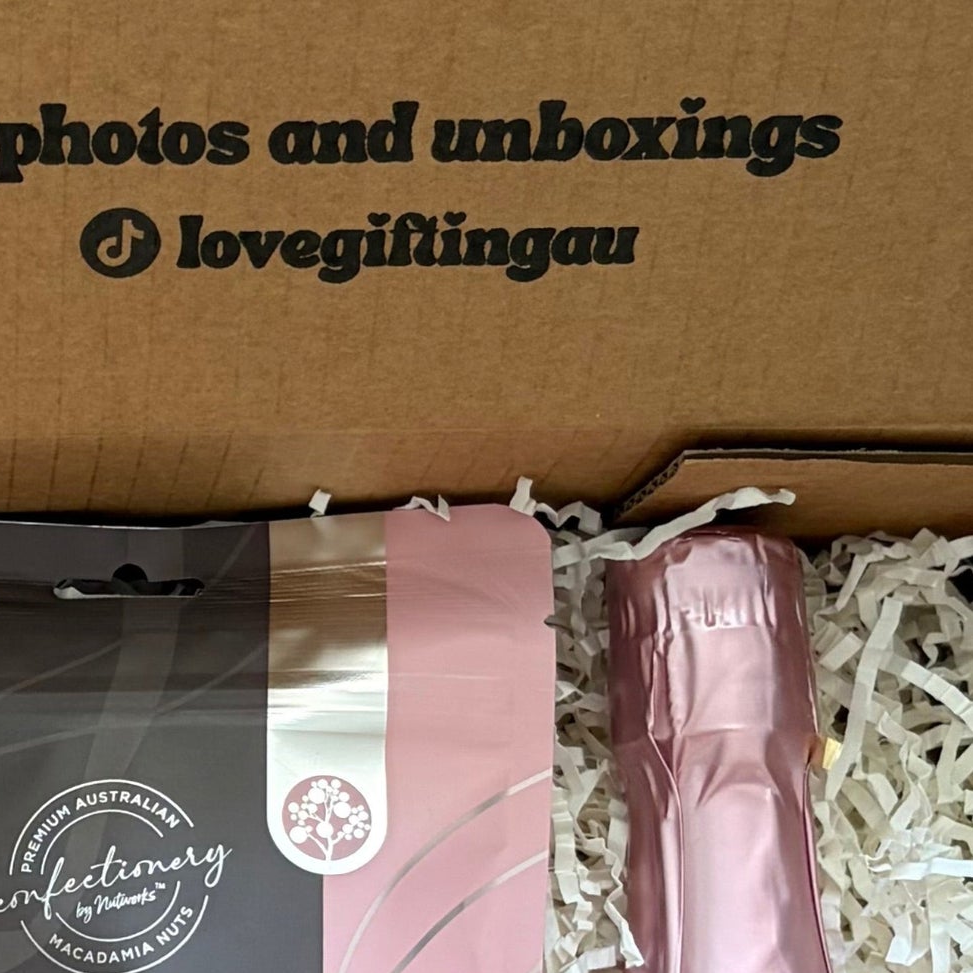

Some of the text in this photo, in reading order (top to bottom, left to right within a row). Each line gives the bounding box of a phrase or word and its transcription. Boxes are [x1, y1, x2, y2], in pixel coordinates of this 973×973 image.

[269, 100, 419, 165] and
[432, 98, 843, 177] unboxings
[176, 211, 640, 284] lovegiftingau
[21, 790, 180, 873] PREMIUM AUSTRALIAN
[49, 906, 193, 964] MACADAMIA NUTS
[76, 902, 92, 924] by
